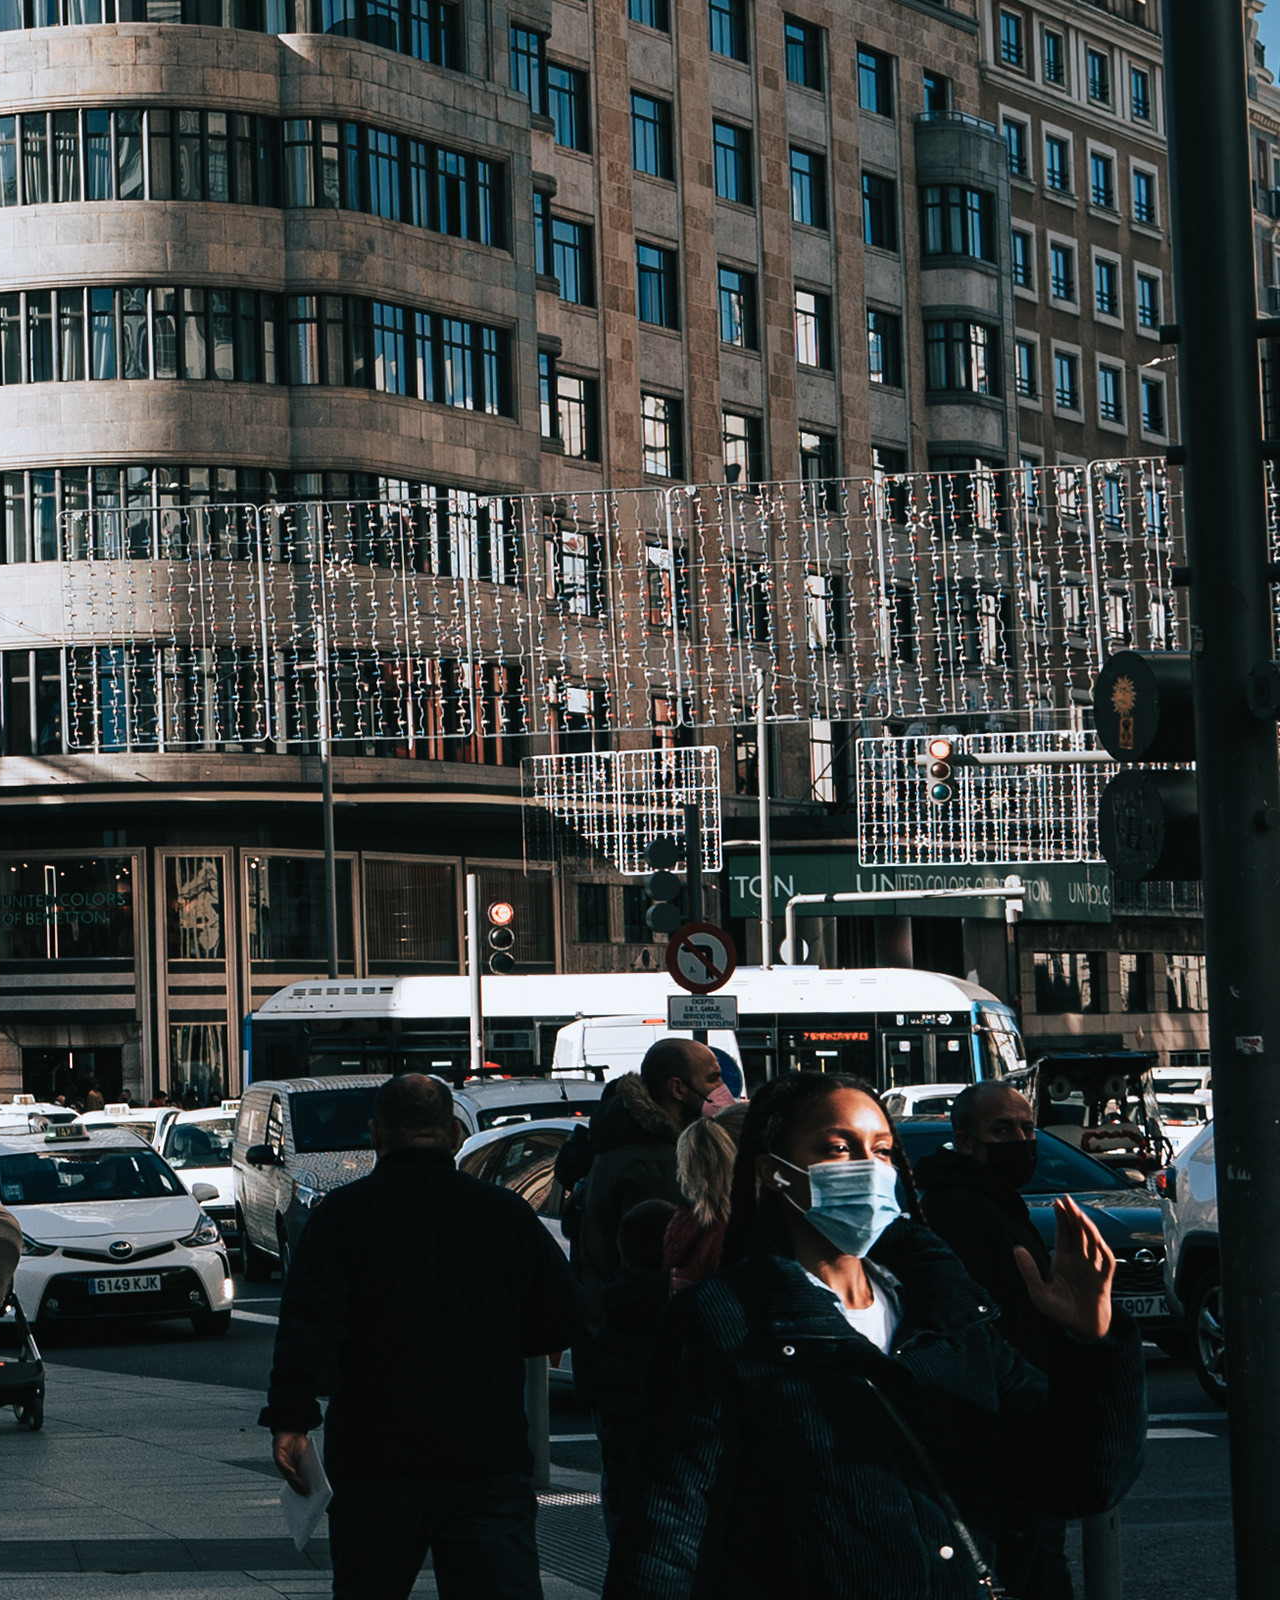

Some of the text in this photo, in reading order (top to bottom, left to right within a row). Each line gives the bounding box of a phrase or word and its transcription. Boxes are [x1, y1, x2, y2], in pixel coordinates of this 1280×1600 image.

[2, 892, 126, 908] UNITED COLORS
[2, 912, 22, 926] OF
[97, 1276, 158, 1292] 6149 KJK
